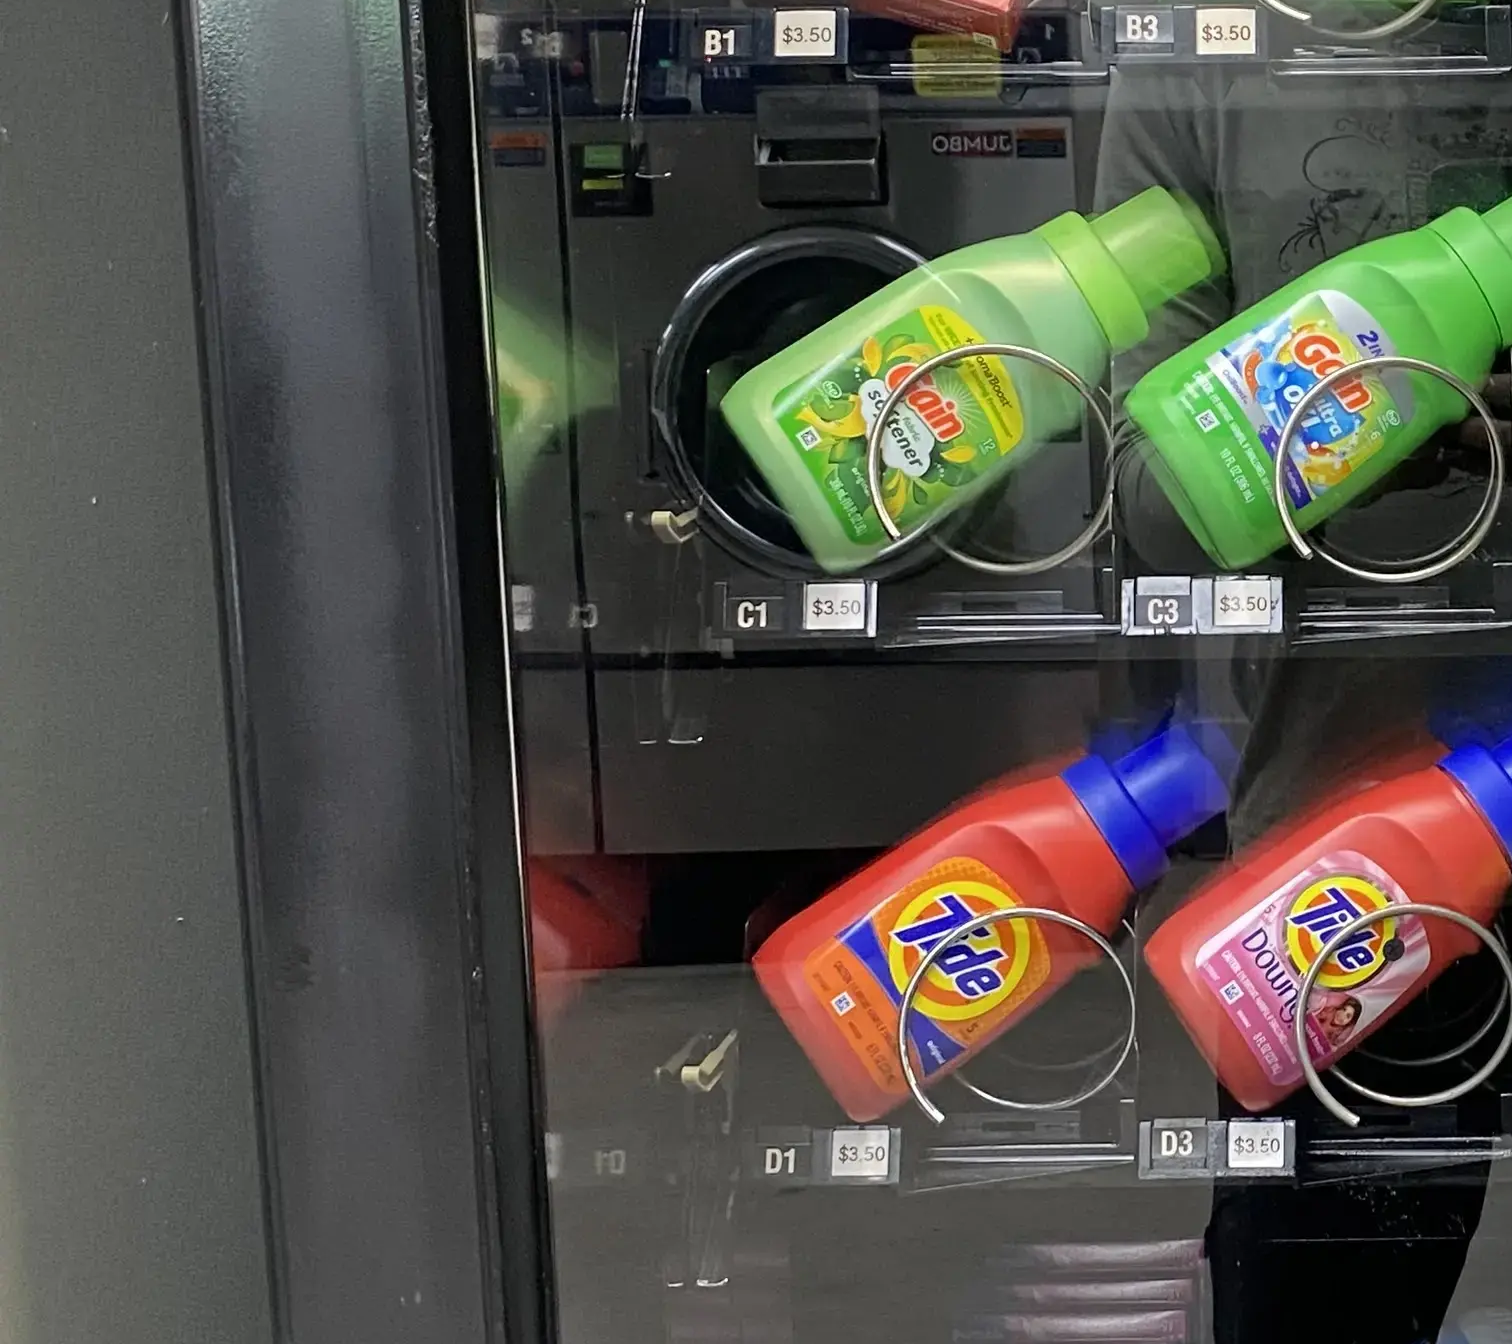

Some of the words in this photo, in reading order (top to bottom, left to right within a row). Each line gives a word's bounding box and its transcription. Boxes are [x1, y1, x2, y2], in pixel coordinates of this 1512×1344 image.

[782, 26, 832, 45] $3.50
[1126, 14, 1159, 41] B3
[1201, 24, 1251, 44] $3.50
[704, 29, 735, 56] B1
[1357, 326, 1379, 348] 2
[1292, 330, 1371, 412] Gain
[885, 362, 965, 443] Gain
[982, 436, 997, 452] 12
[736, 600, 769, 629] C1
[811, 598, 861, 617] $3.50
[1147, 599, 1180, 625] C3
[1218, 596, 1268, 613] $3.50
[1288, 886, 1380, 972] Tide
[889, 892, 1008, 1000] Tide
[838, 1145, 885, 1164] $3.50
[1160, 1130, 1194, 1157] D3
[1233, 1137, 1281, 1154] $3.50
[765, 1147, 797, 1175] D1
